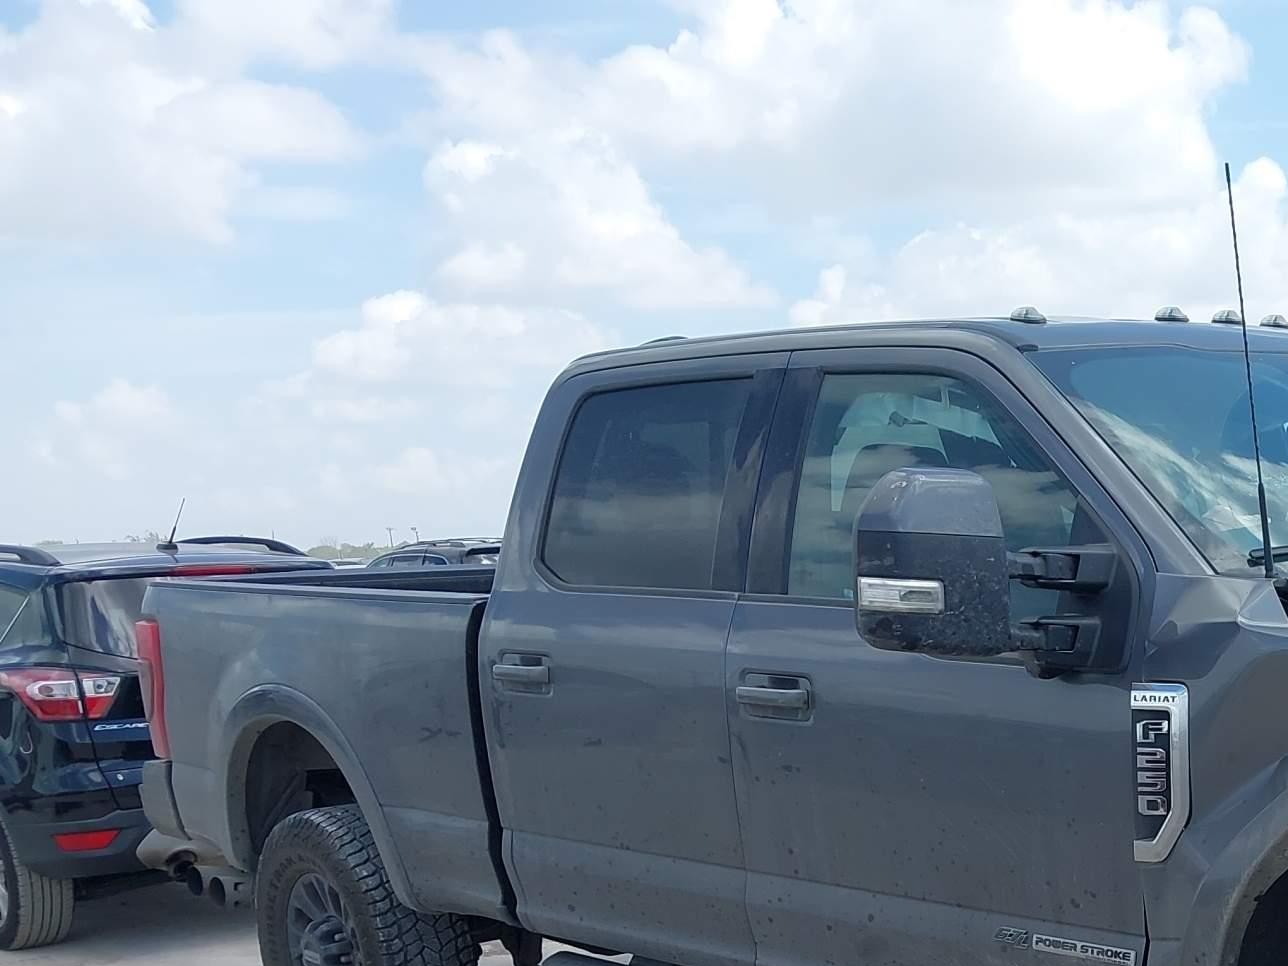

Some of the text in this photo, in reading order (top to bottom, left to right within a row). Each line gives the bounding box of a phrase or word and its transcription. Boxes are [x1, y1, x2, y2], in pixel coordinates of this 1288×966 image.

[1133, 694, 1177, 703] LARIAT
[1035, 936, 1078, 952] POWER
[1080, 944, 1131, 962] STROKE
